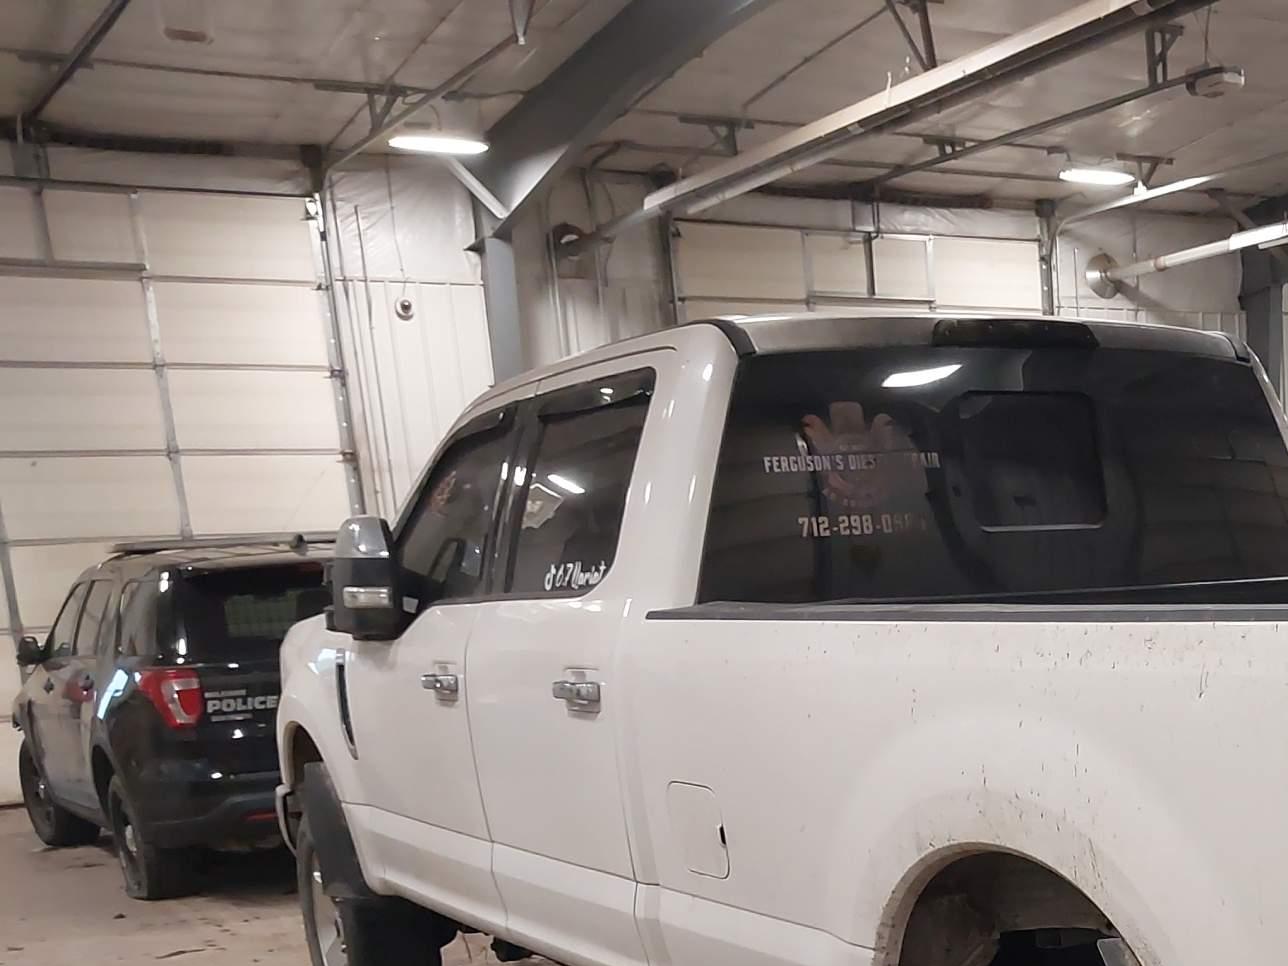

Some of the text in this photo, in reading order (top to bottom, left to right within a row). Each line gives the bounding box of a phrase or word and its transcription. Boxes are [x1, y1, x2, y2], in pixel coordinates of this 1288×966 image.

[763, 454, 845, 474] FERGUSON'S
[849, 452, 881, 471] DIES
[798, 513, 920, 538] 712-298-0
[206, 695, 279, 713] POLICE
